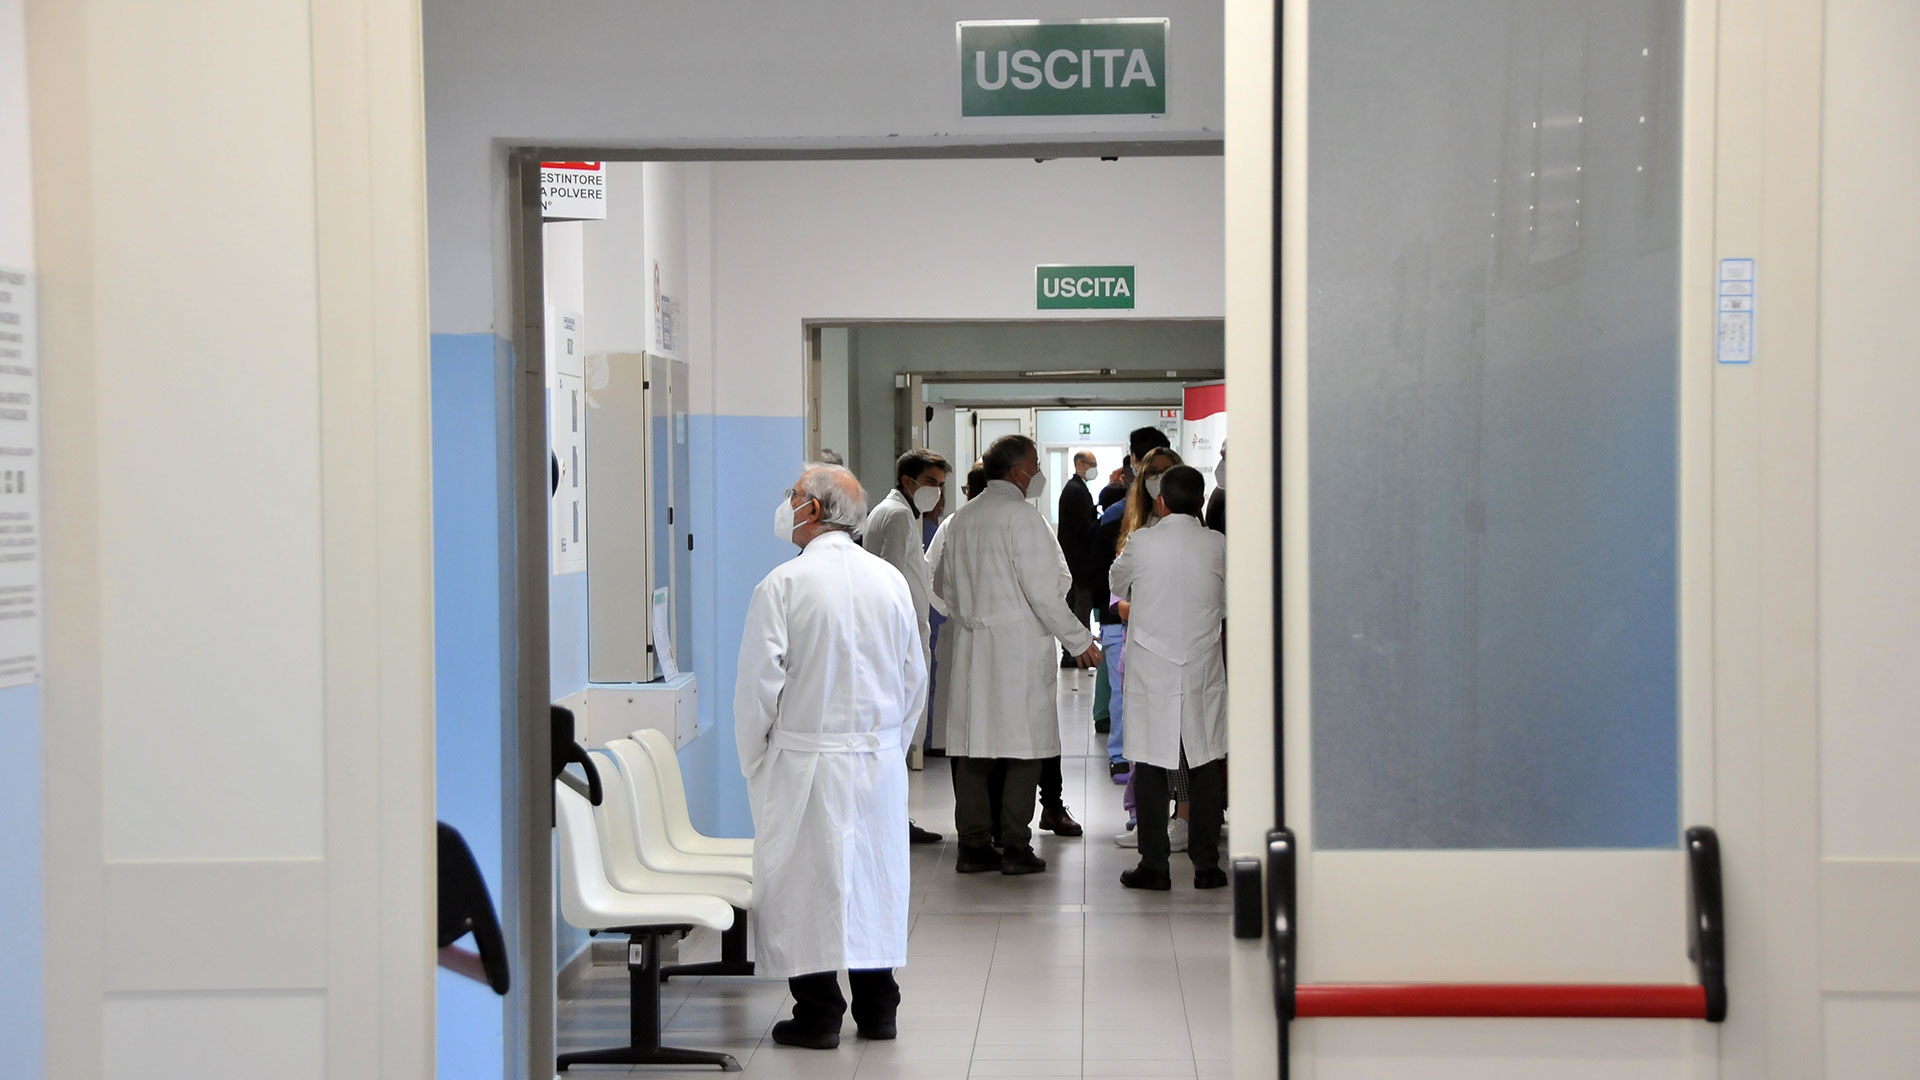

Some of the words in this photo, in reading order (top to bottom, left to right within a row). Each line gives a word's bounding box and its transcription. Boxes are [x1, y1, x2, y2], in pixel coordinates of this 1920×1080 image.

[975, 48, 1156, 91] USCITA
[540, 172, 602, 186] ESTINTORE
[540, 186, 547, 197] A
[550, 187, 602, 200] POLVERE
[1043, 277, 1131, 298] USCITA
